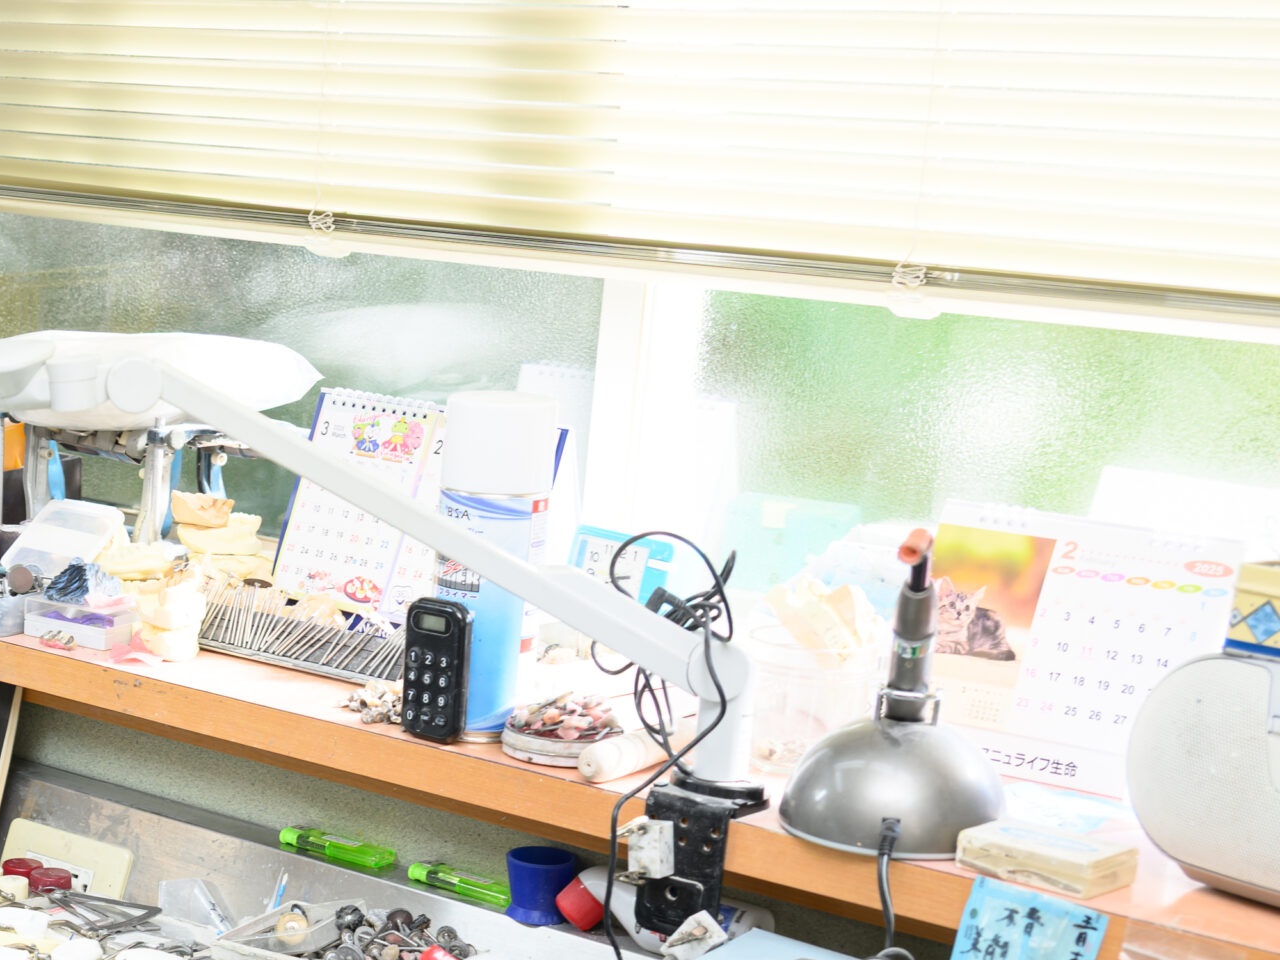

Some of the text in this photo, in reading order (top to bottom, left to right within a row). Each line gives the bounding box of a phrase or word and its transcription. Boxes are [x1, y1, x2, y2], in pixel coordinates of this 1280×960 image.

[321, 421, 330, 435] 3
[433, 440, 444, 454] 2
[1060, 541, 1225, 576] 2 2025
[1064, 612, 1071, 621] 3
[1088, 616, 1095, 625] 4
[1113, 620, 1120, 629] 5
[1138, 624, 1145, 633] 6
[1165, 627, 1172, 637] 7
[410, 651, 447, 667] 1 2 3
[1057, 642, 1069, 652] 10
[1106, 650, 1118, 661] 12
[1131, 654, 1143, 664] 13
[1156, 658, 1168, 668] 14
[408, 671, 445, 687] 4 5 6
[1049, 672, 1061, 681] 17
[1073, 676, 1085, 686] 18
[1098, 680, 1110, 691] 19
[1121, 684, 1135, 695] 20
[408, 691, 444, 707] 7 8 9
[406, 710, 413, 720] 0
[1064, 706, 1078, 717] 25
[1089, 710, 1102, 721] 26
[1113, 714, 1127, 725] 27
